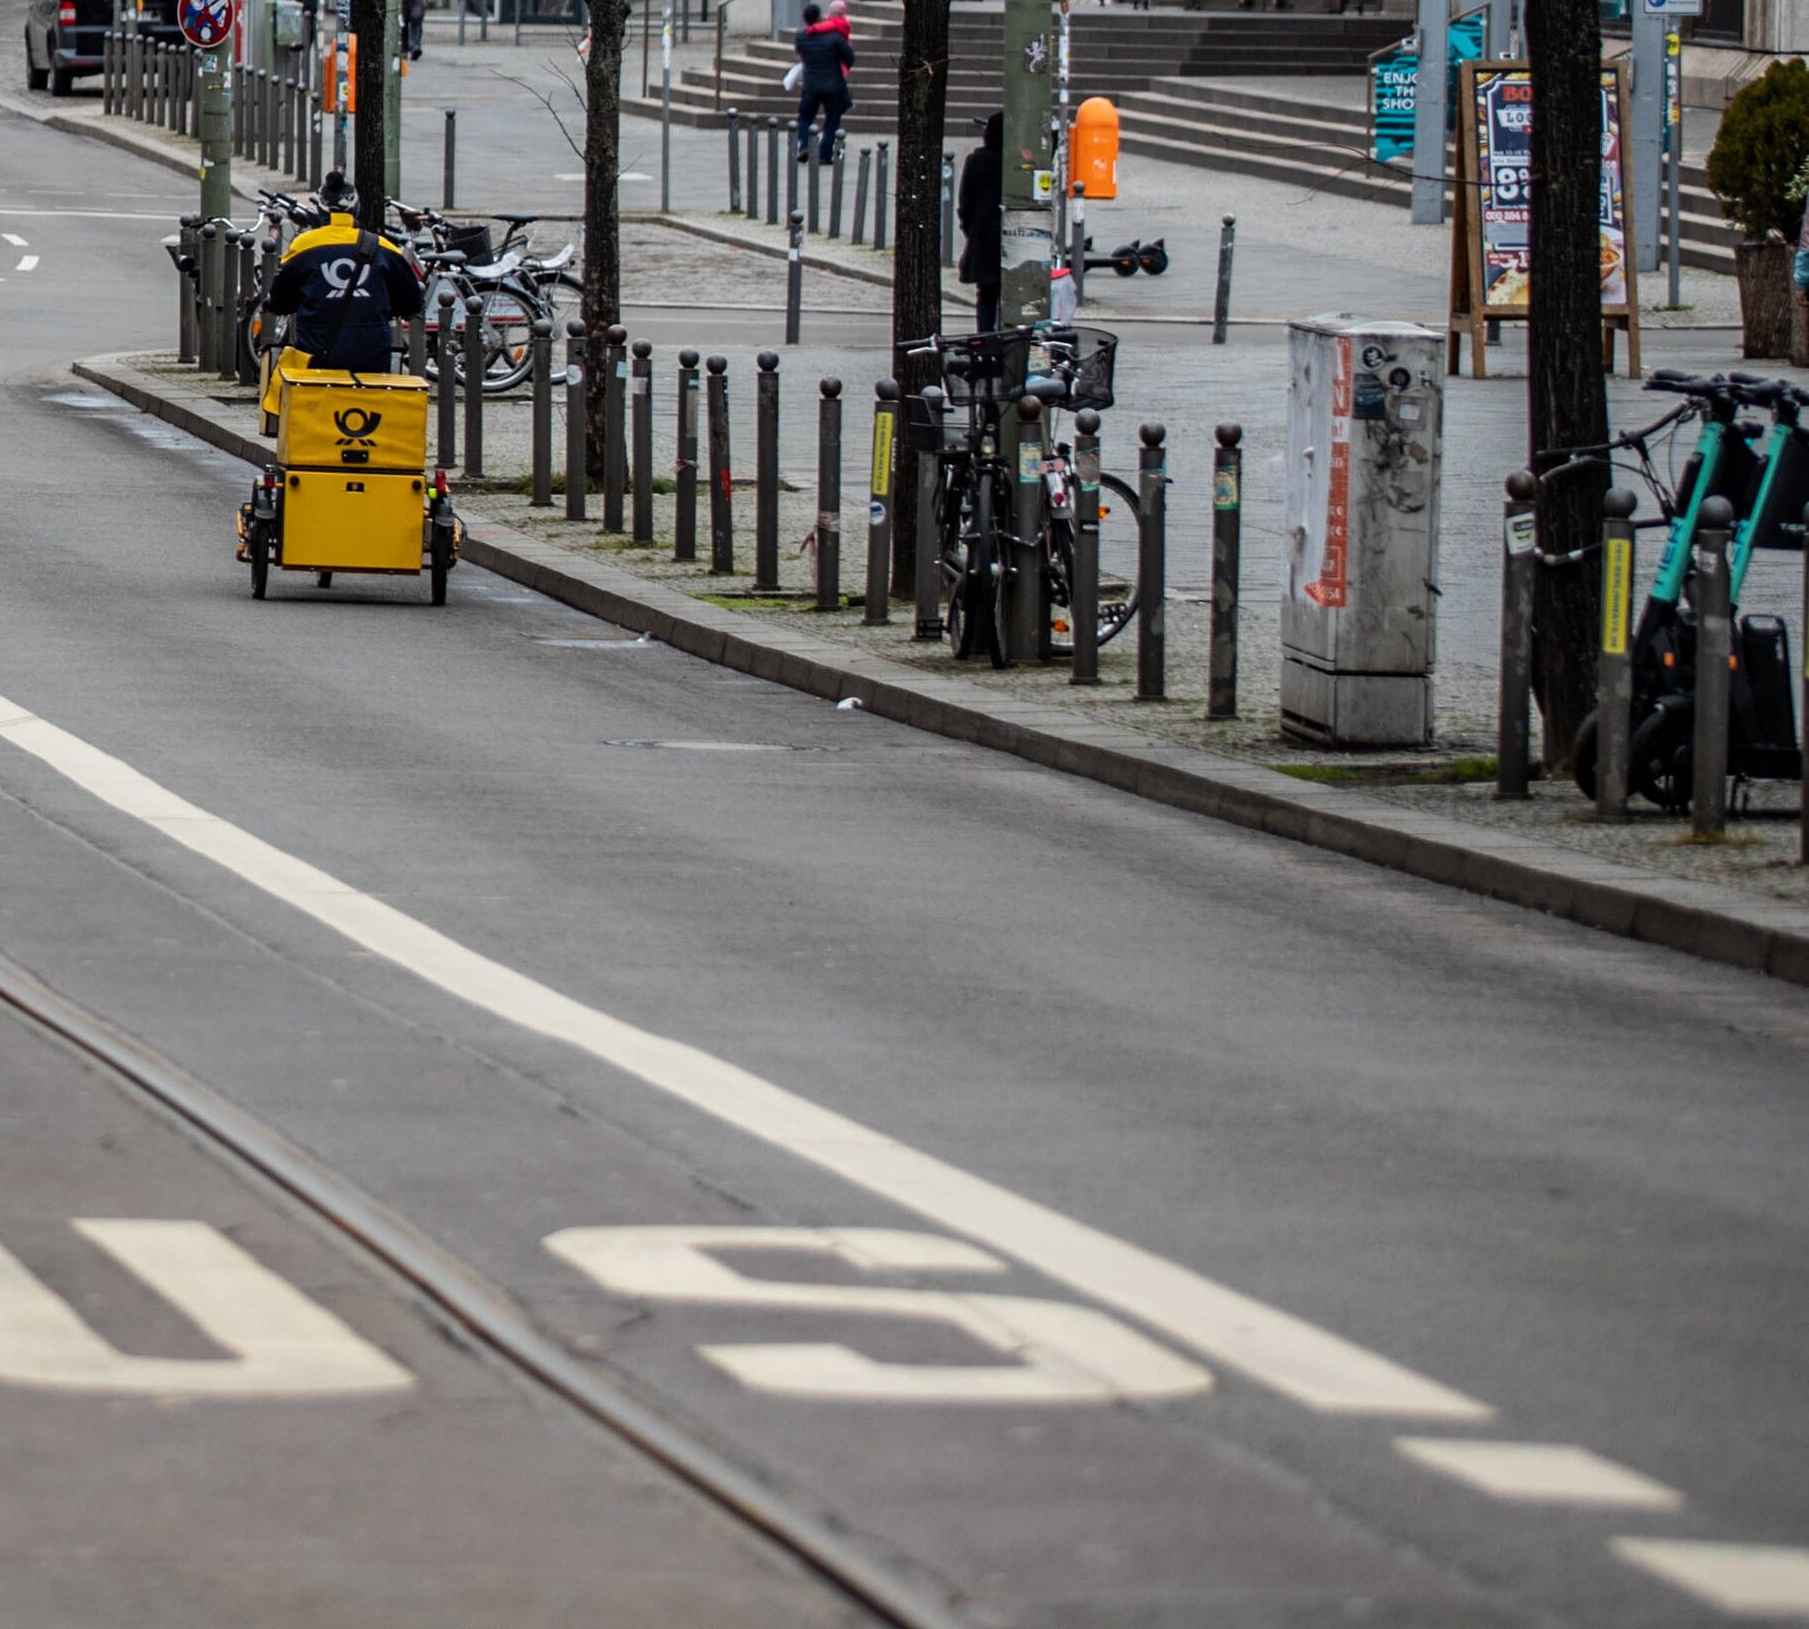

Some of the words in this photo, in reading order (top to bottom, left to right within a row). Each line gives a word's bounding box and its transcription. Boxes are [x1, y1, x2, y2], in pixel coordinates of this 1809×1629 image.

[1383, 72, 1418, 84] ENJ
[1394, 85, 1415, 97] TH
[1382, 98, 1415, 110] SHO
